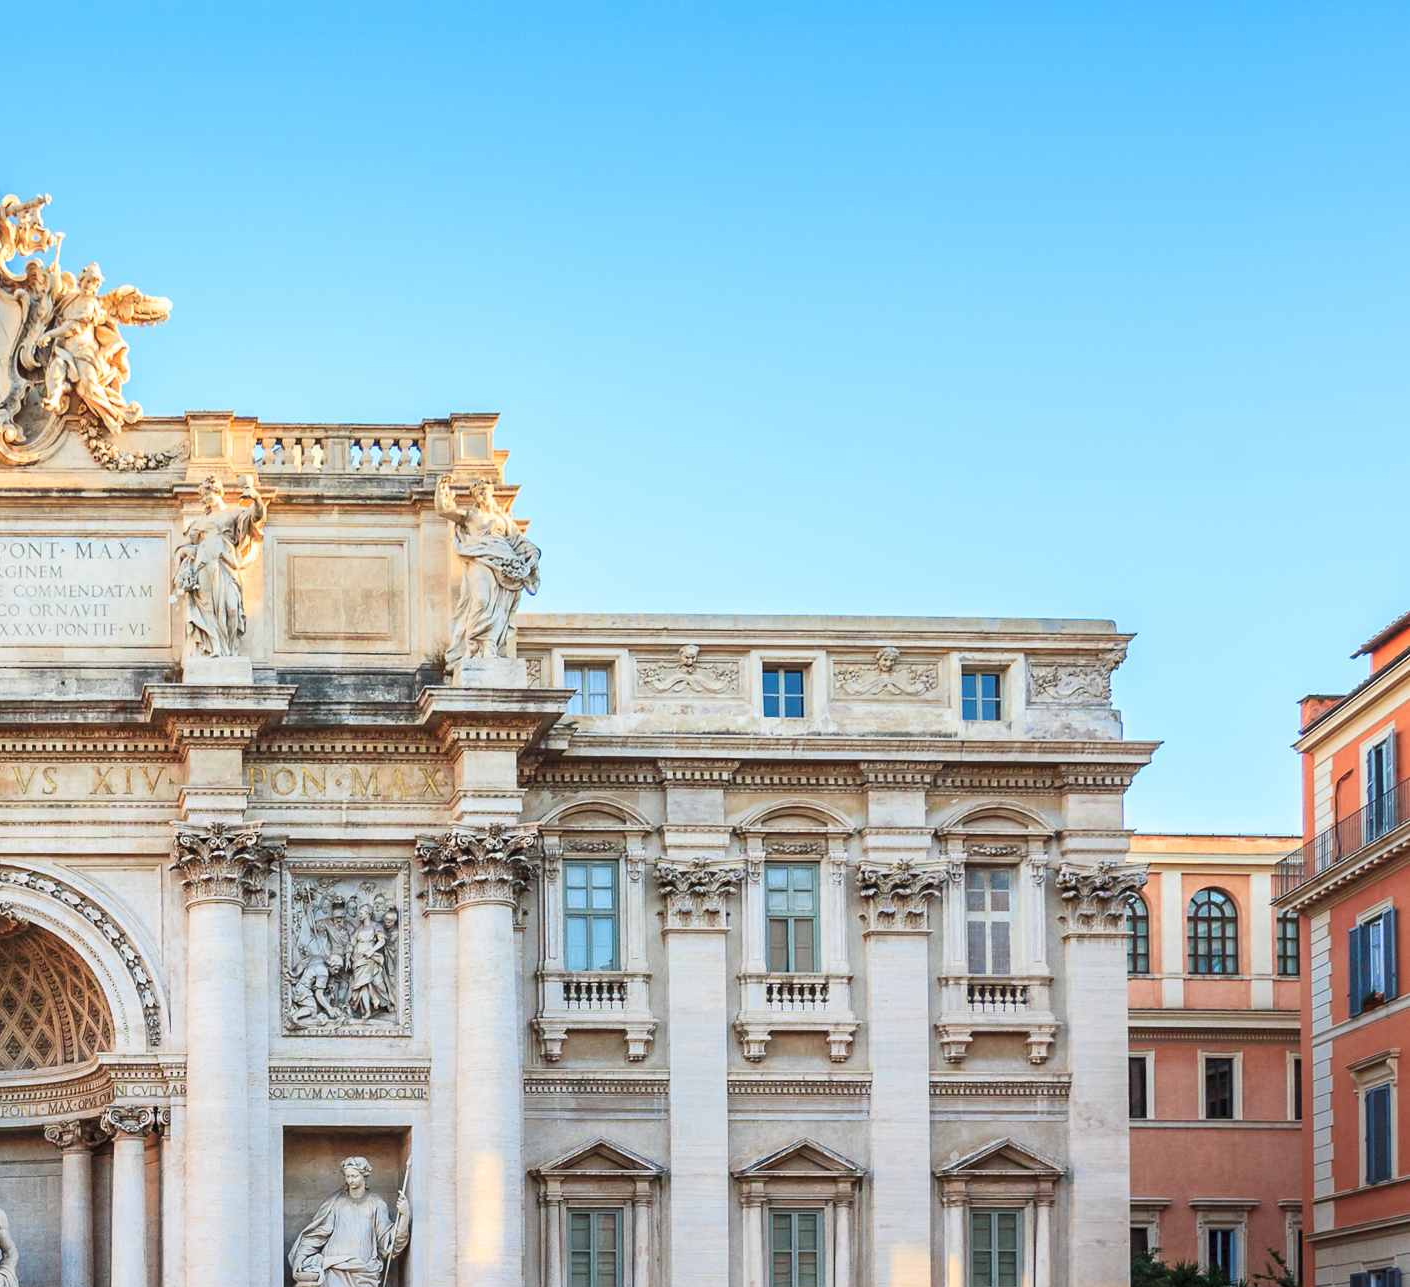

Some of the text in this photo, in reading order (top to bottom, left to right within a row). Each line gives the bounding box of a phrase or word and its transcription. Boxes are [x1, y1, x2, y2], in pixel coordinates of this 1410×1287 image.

[14, 585, 153, 598] COMMENDATAM
[29, 604, 110, 617] ORNAVIT
[170, 1084, 187, 1095] AB
[268, 1087, 322, 1099] SOLVTVM
